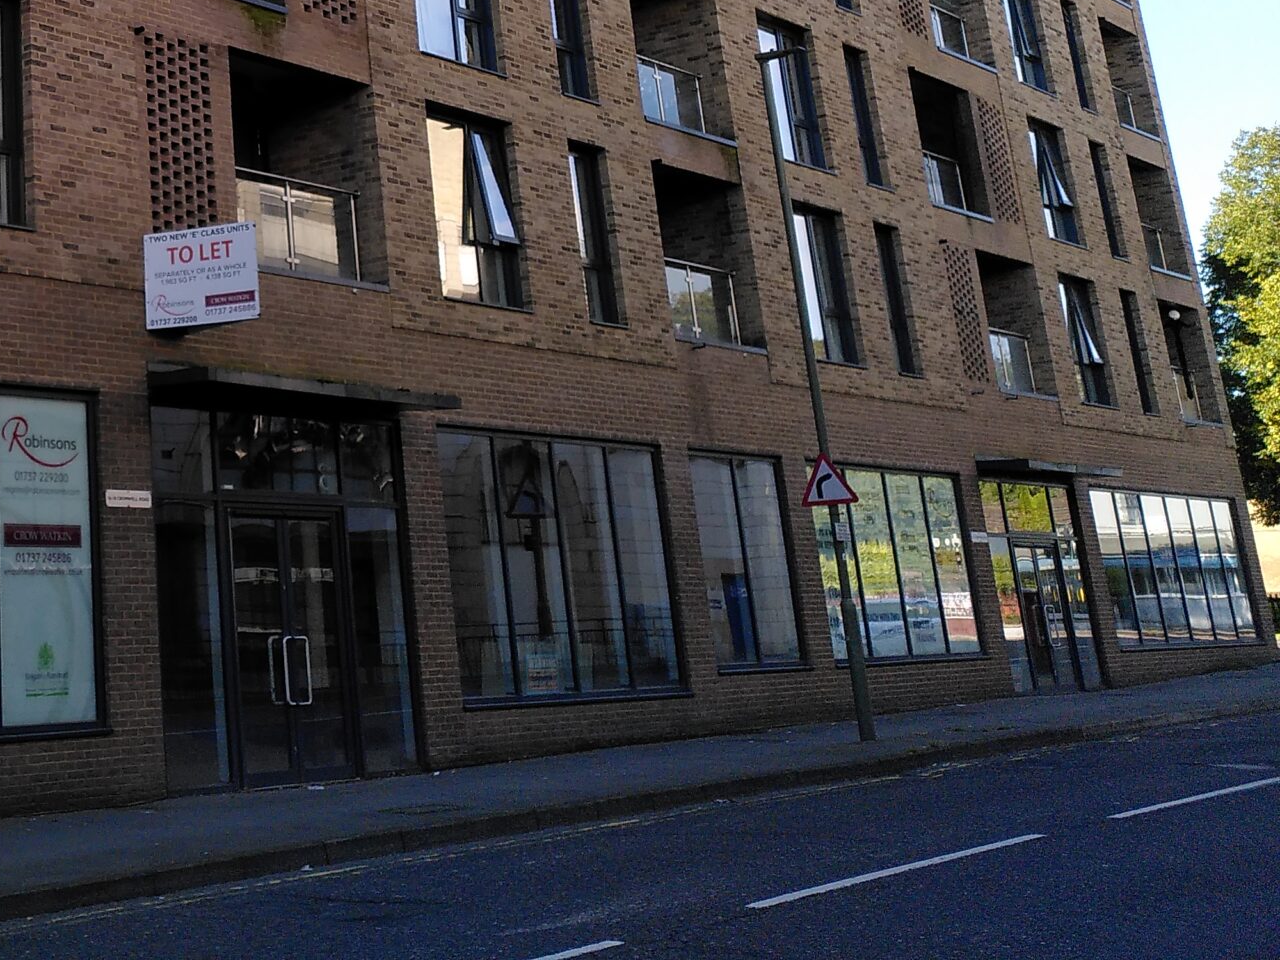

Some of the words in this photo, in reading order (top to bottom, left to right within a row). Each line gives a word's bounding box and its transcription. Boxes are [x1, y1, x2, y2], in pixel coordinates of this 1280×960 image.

[170, 234, 189, 242] NEW
[201, 228, 225, 238] CLASS
[227, 224, 250, 233] UNITS
[167, 246, 193, 265] TO
[200, 240, 233, 261] LET
[155, 269, 195, 279] SEPARATELY
[224, 262, 247, 270] WHOLE
[205, 307, 226, 316] 01737
[150, 317, 171, 326] 01737
[2, 416, 79, 467] Robinsons
[16, 553, 39, 563] 01737
